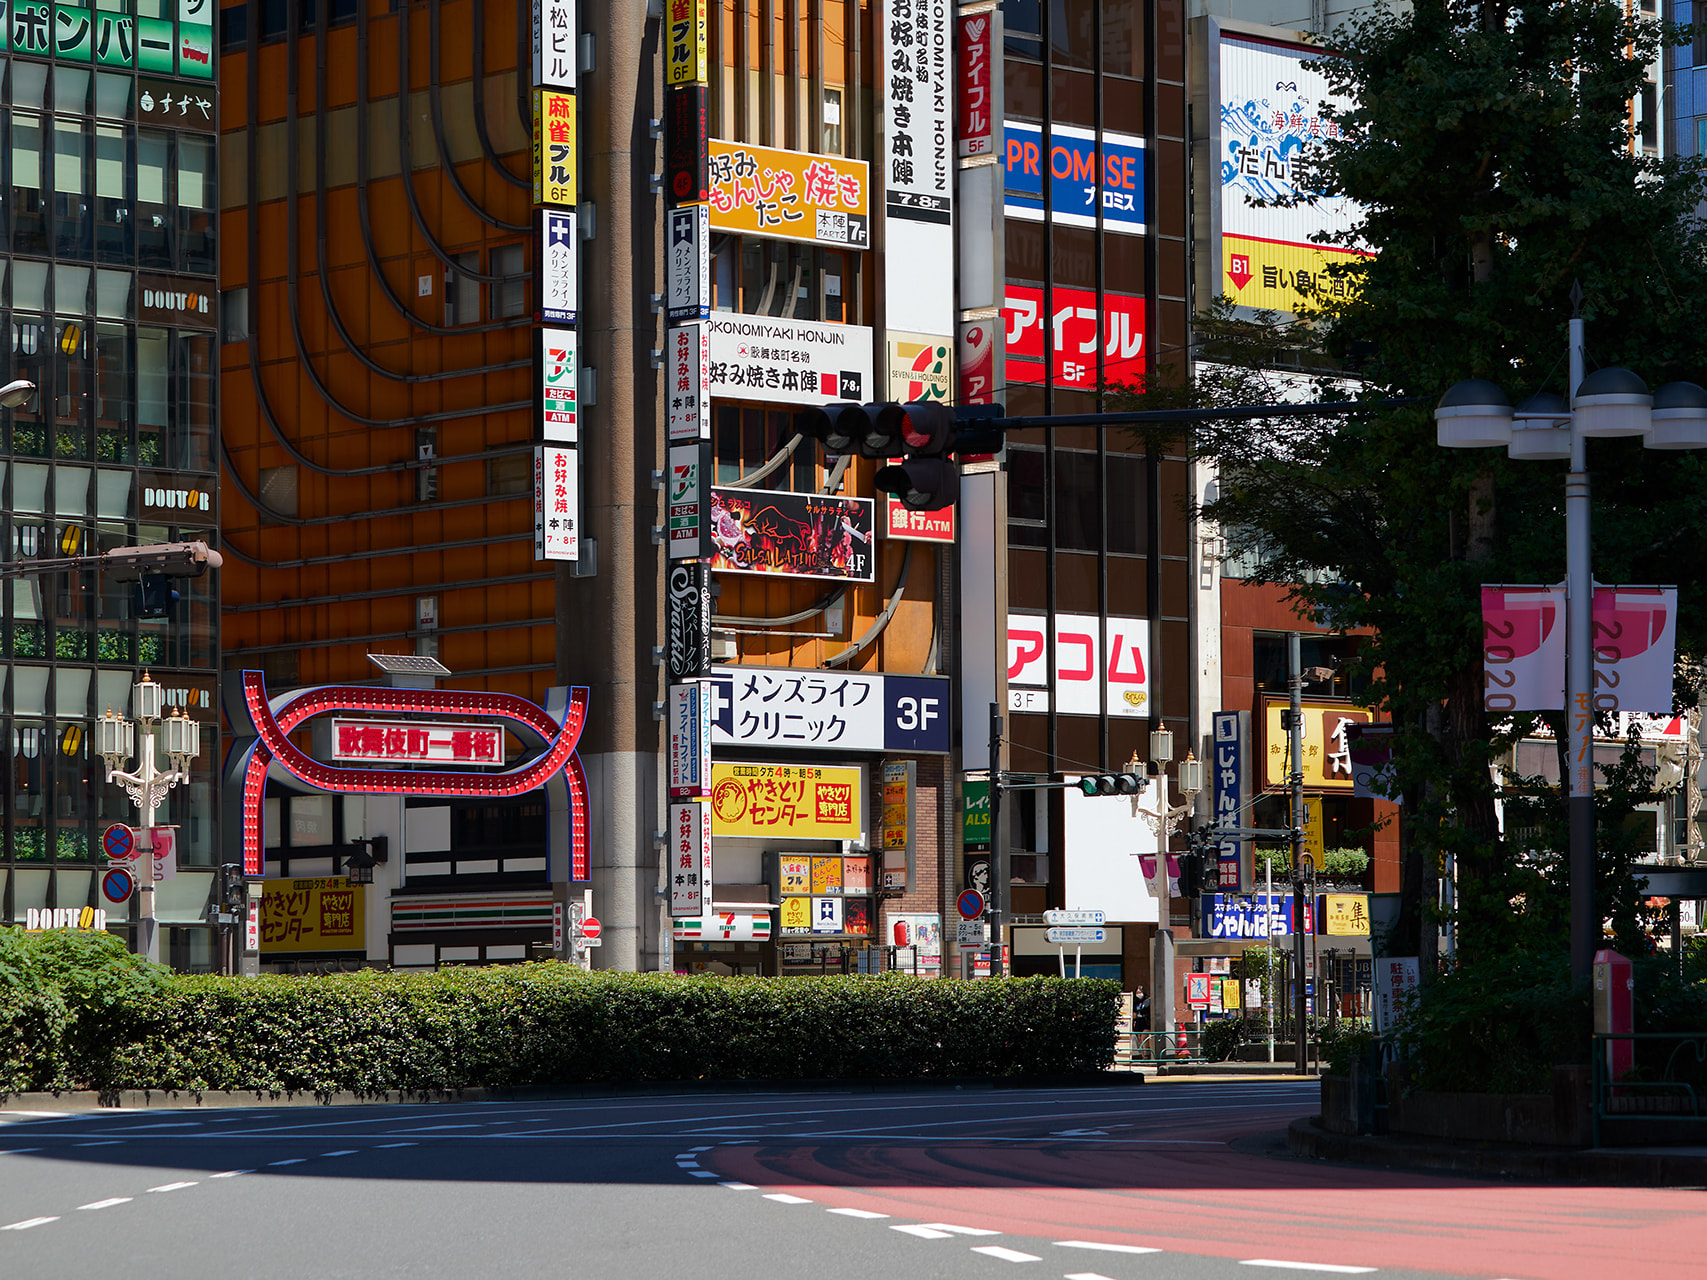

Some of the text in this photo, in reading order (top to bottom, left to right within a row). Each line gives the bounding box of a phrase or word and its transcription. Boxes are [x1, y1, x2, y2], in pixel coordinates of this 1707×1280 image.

[0, 1, 170, 62] ポンバー
[673, 64, 689, 81] 6F
[967, 45, 986, 134] アイフル
[159, 92, 212, 121] すずや
[1270, 109, 1356, 142] 海鮮居酒
[548, 95, 571, 187] 麻雀ブル
[968, 139, 984, 153] 5F
[934, 119, 946, 191] HONJIN
[1006, 138, 1136, 190] PROMISE
[550, 187, 568, 202] 6F
[710, 169, 796, 214] もんじゃ
[804, 160, 862, 208] 焼き
[756, 193, 804, 227] たこ
[1083, 187, 1136, 212] プロミス
[817, 212, 846, 231] 本陣
[849, 220, 867, 242] 7F
[550, 249, 559, 298] クリニック
[560, 250, 569, 309] メンズライフ
[674, 247, 683, 298] クリニック
[682, 246, 691, 305] メンズライフ
[1232, 259, 1248, 275] B1
[143, 289, 209, 314] DOUTOR
[689, 306, 698, 317] 3F
[700, 307, 710, 317] 3F
[566, 311, 576, 321] 3F
[1005, 297, 1144, 359] アイフル
[707, 320, 845, 346] OKONOMIYAKI HONJIN
[676, 331, 690, 393] お好み焼
[700, 334, 709, 391] お好み焼
[750, 346, 811, 364] 歌舞伎町名物
[917, 372, 949, 384] HOLDINGS
[1062, 361, 1086, 383] 5F
[549, 389, 572, 401] たばこ
[671, 396, 696, 411] 本陣
[550, 413, 570, 423] ATM
[535, 456, 543, 514] お好み焼
[553, 452, 568, 514] お好み焼
[144, 487, 210, 511] DOUTOR
[674, 505, 696, 516] たばこ
[548, 517, 575, 532] 本陣
[675, 529, 694, 540] ATM
[924, 519, 951, 533] ATM
[734, 541, 772, 568] SALSA
[846, 553, 866, 573] 4F
[670, 567, 699, 676] Sparkle
[684, 606, 699, 675] スパークル
[1008, 629, 1147, 686] アコム
[1482, 620, 1517, 711] 2020
[1592, 620, 1624, 711] 2020
[738, 674, 872, 706] メンズライフ
[1013, 693, 1035, 709] 3F
[702, 693, 710, 757] ファイトフィット
[896, 695, 940, 732] 3F
[739, 709, 847, 744] クリニック
[338, 725, 497, 760] 歌舞伎町一番街
[679, 703, 689, 784] ファイトフィット
[747, 778, 806, 803] やきとり
[817, 785, 851, 802] やきとり
[749, 802, 809, 827] センター
[818, 801, 848, 816] 専門店
[965, 813, 990, 826] ALS
[679, 808, 692, 869] お好み焼
[703, 812, 711, 869] お好み焼
[674, 872, 698, 887] 本陣
[1219, 862, 1237, 873] 高価
[260, 890, 311, 918] やきとり
[322, 894, 353, 912] やきとり
[26, 906, 107, 931] DOUTOR
[260, 918, 314, 943] センター
[1347, 961, 1371, 972] SUB
